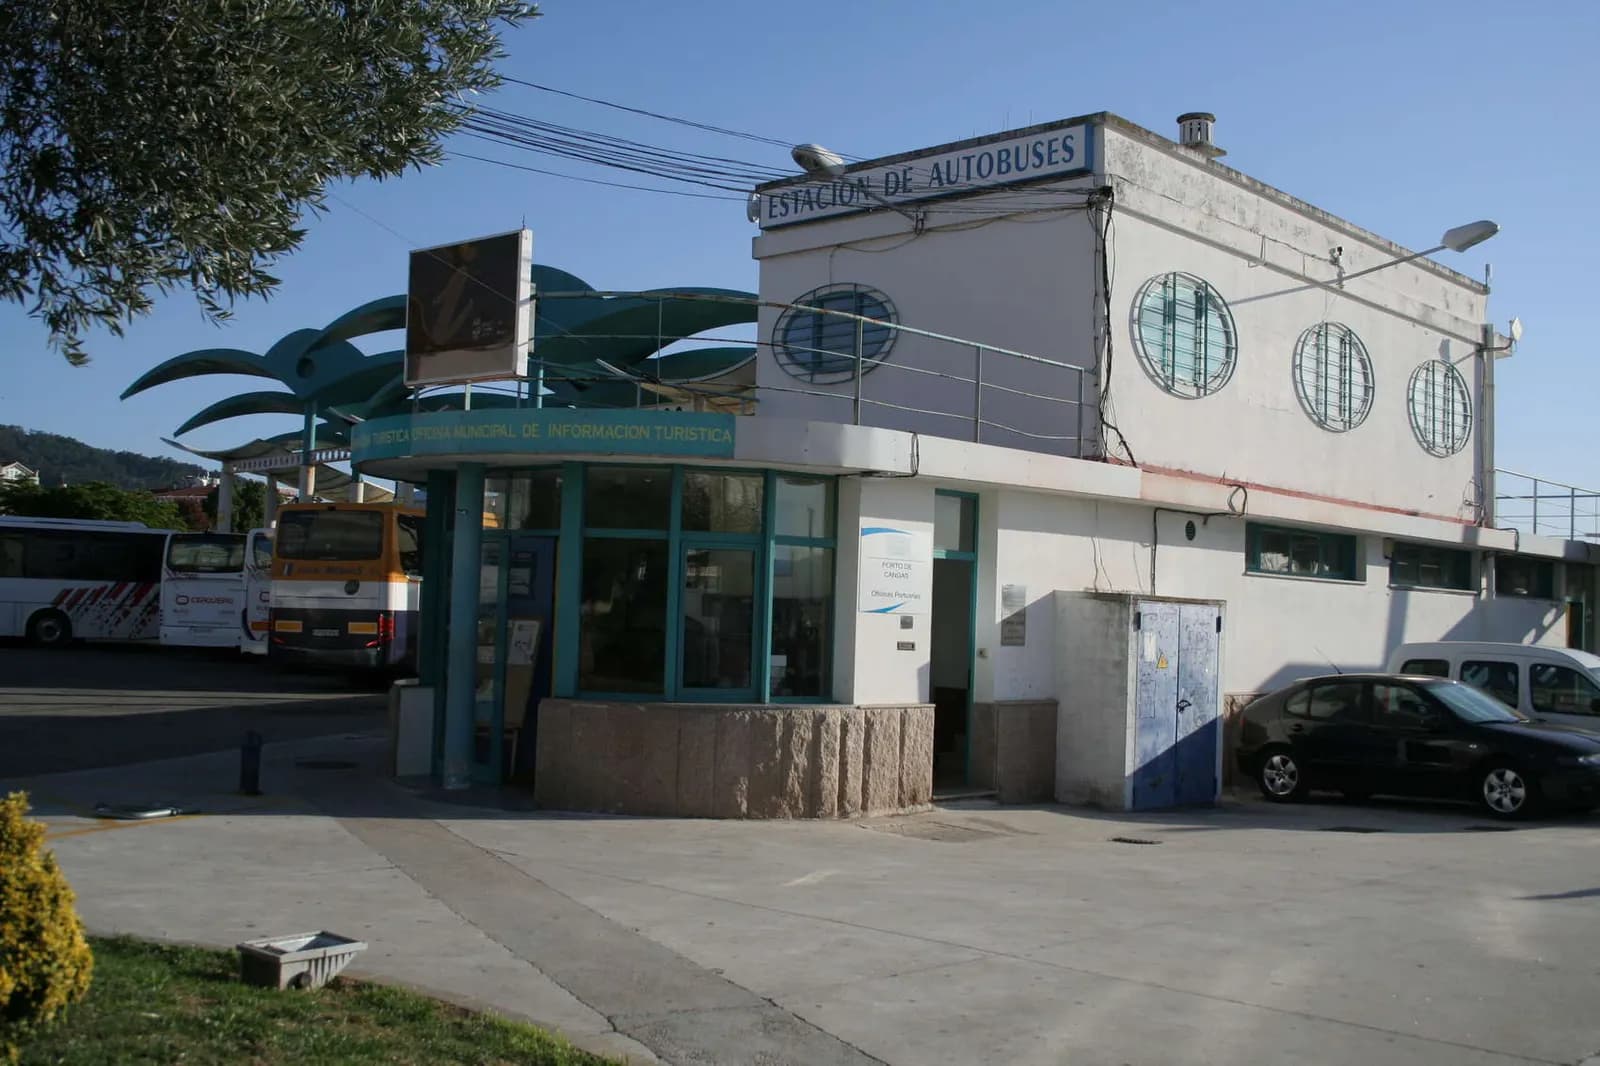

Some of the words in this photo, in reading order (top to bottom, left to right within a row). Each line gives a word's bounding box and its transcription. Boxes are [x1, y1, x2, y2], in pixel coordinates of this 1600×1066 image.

[768, 176, 870, 219] ESTACION
[884, 166, 913, 197] DE
[928, 134, 1075, 187] AUTOBUSES
[454, 424, 515, 438] MUNICIPAL
[522, 423, 538, 438] DE
[548, 424, 650, 440] INFORMACION
[654, 426, 732, 443] TURISTICA
[882, 562, 903, 570] PORTO
[884, 571, 909, 579] CANGAS
